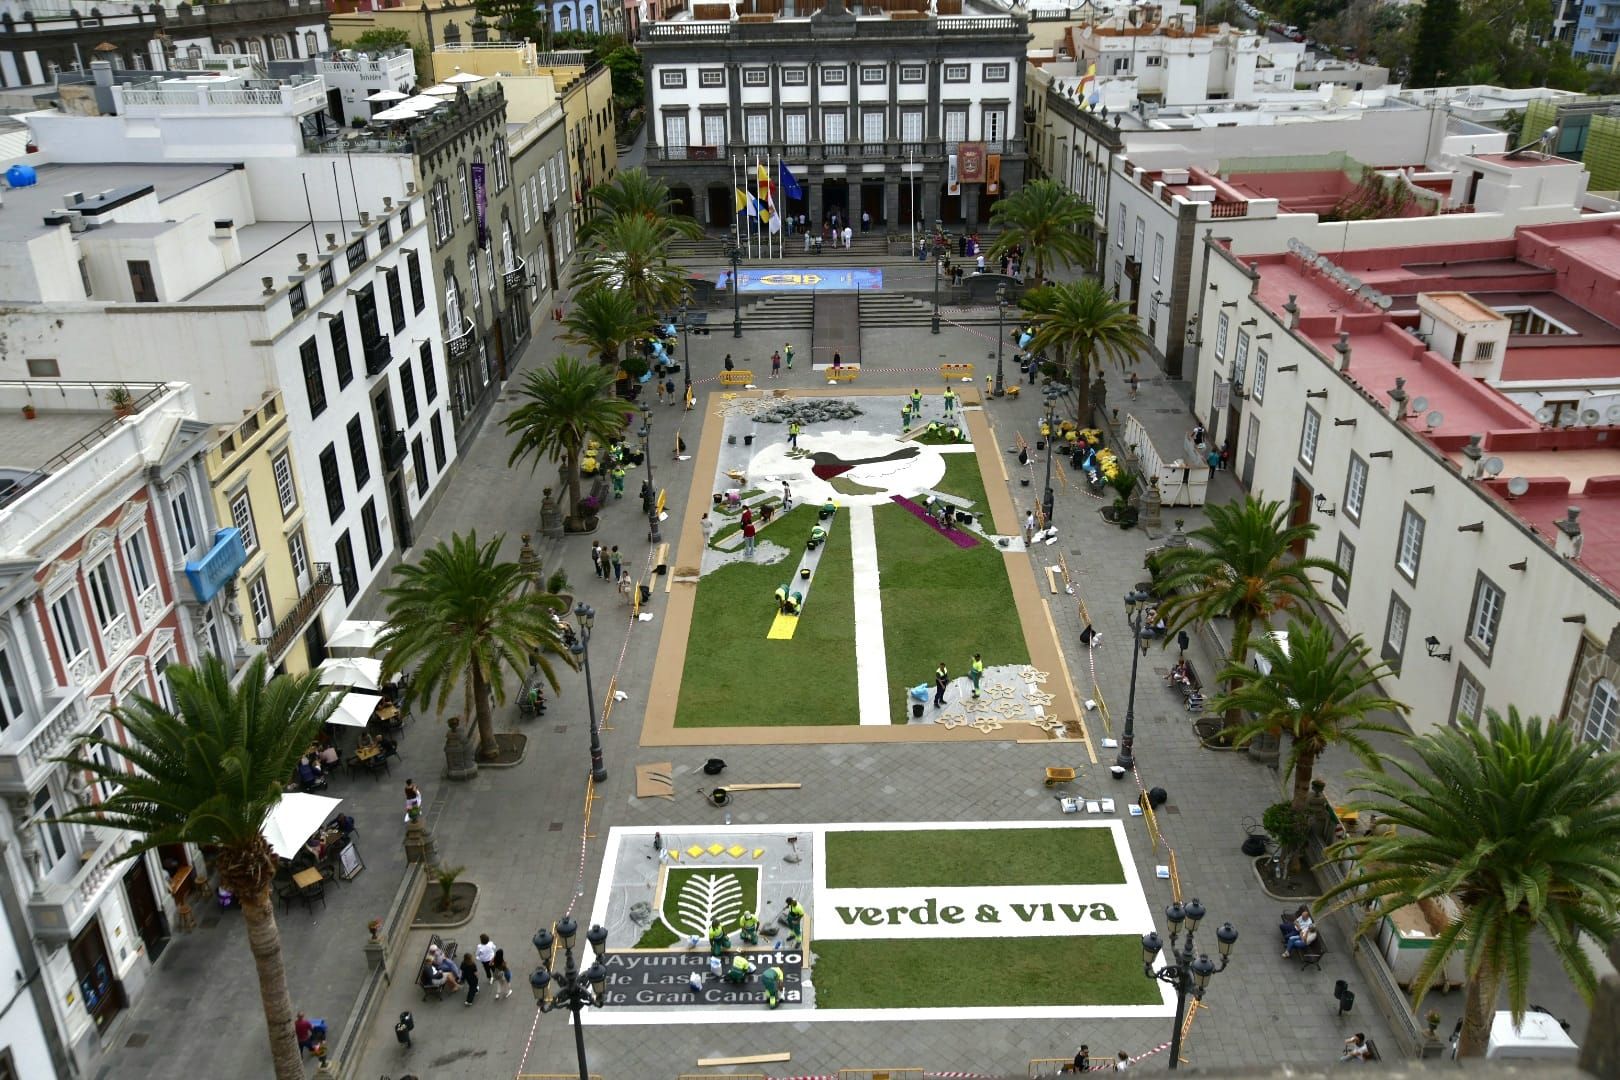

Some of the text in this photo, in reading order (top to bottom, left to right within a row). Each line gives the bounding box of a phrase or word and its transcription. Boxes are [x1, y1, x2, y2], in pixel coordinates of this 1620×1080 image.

[835, 898, 1119, 926] verde & viva
[643, 972, 690, 985] Las
[636, 989, 695, 1003] Gran
